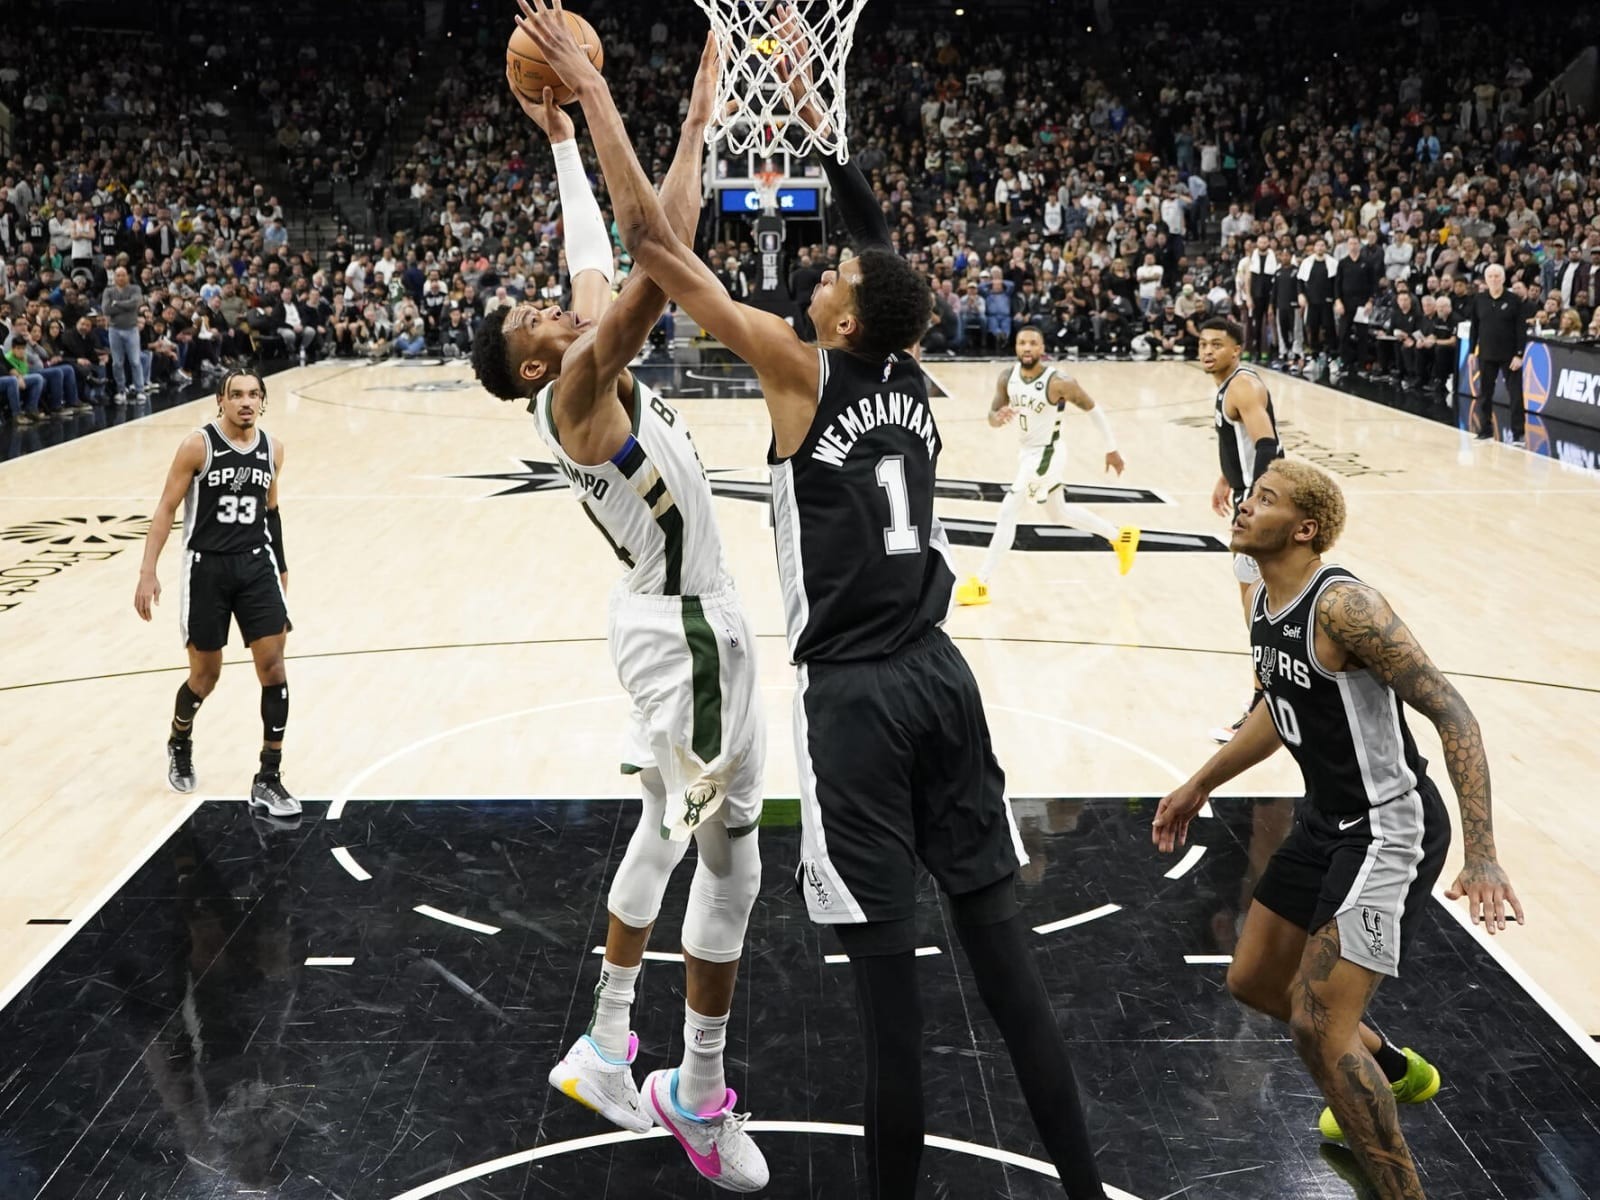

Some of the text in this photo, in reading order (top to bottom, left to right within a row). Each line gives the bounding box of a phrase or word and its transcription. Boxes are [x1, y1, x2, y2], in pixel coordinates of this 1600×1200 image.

[207, 466, 272, 492] SPURS
[216, 494, 258, 525] 33
[874, 454, 921, 556] 1
[1253, 644, 1311, 690] PURS
